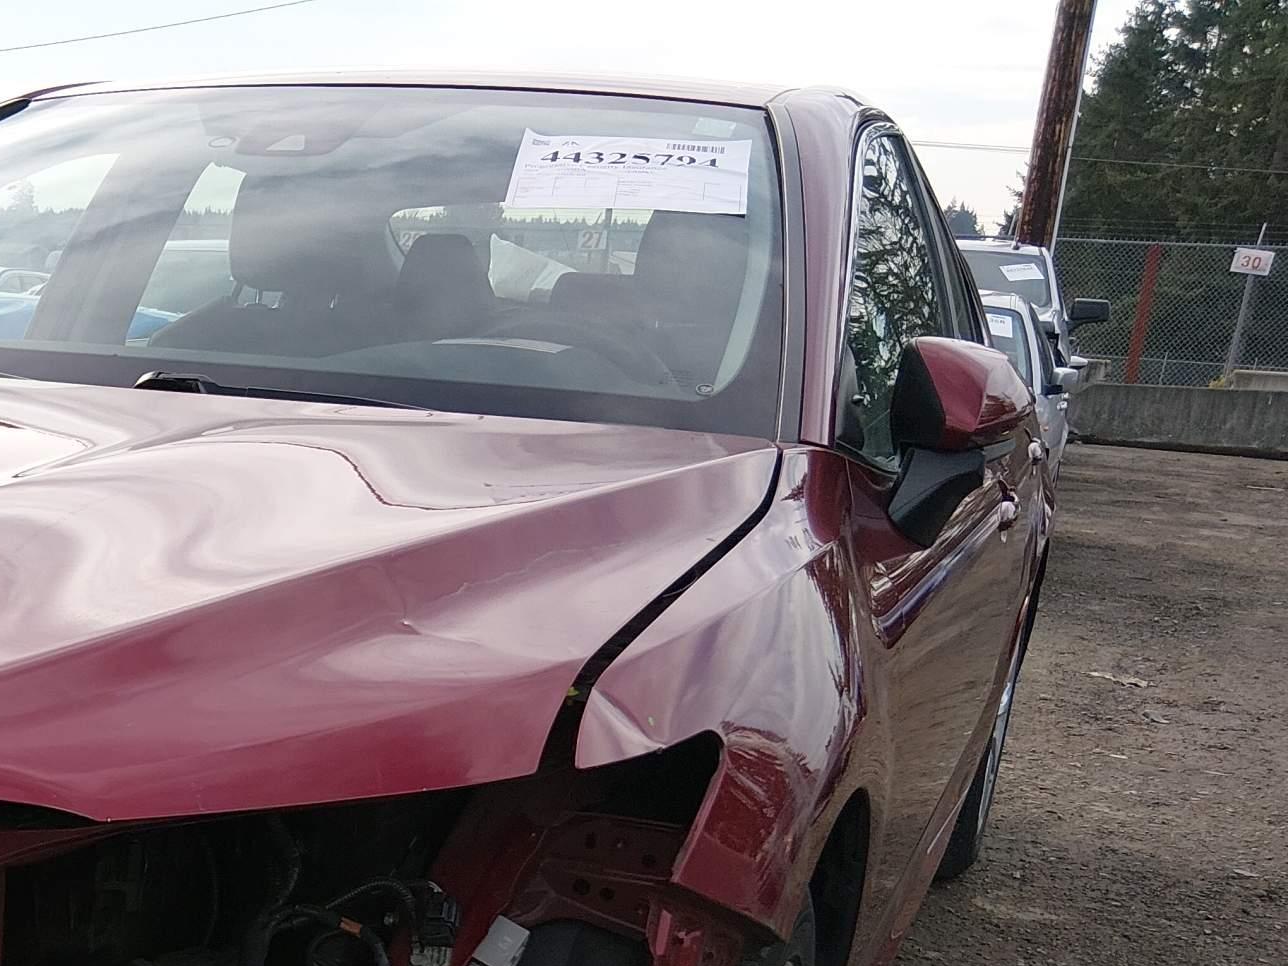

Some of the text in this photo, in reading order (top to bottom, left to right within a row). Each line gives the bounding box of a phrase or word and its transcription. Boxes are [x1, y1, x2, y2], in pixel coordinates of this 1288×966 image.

[540, 150, 719, 168] 44325794
[582, 231, 602, 249] 27
[1241, 255, 1262, 269] 30
